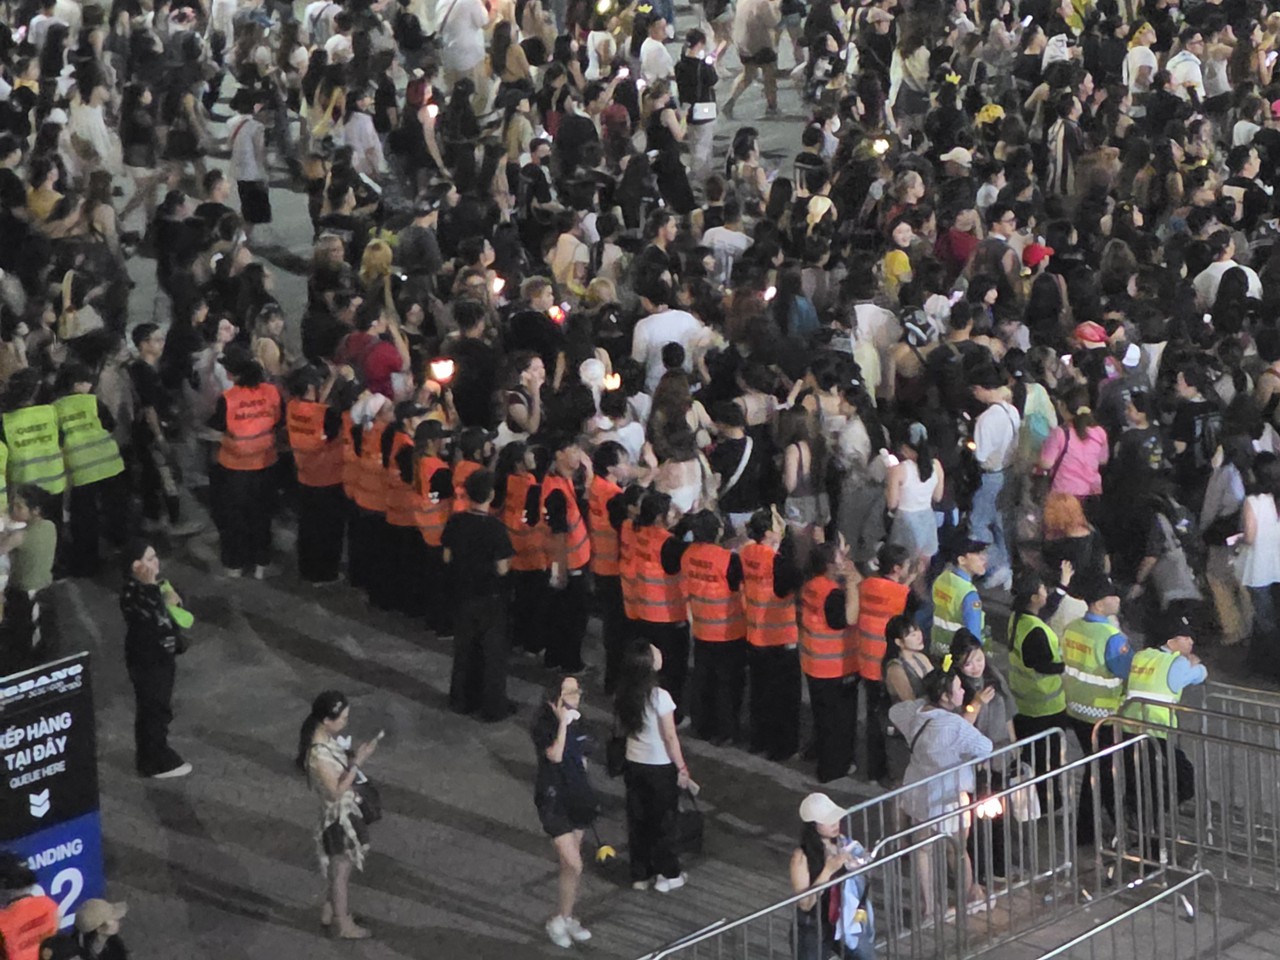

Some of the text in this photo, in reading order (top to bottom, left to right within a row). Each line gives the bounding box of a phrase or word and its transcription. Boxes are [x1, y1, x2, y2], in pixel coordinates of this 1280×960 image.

[26, 712, 72, 741] HÀNG
[4, 735, 67, 771] TẠI ĐÂY
[9, 760, 66, 789] QUEUE HERE
